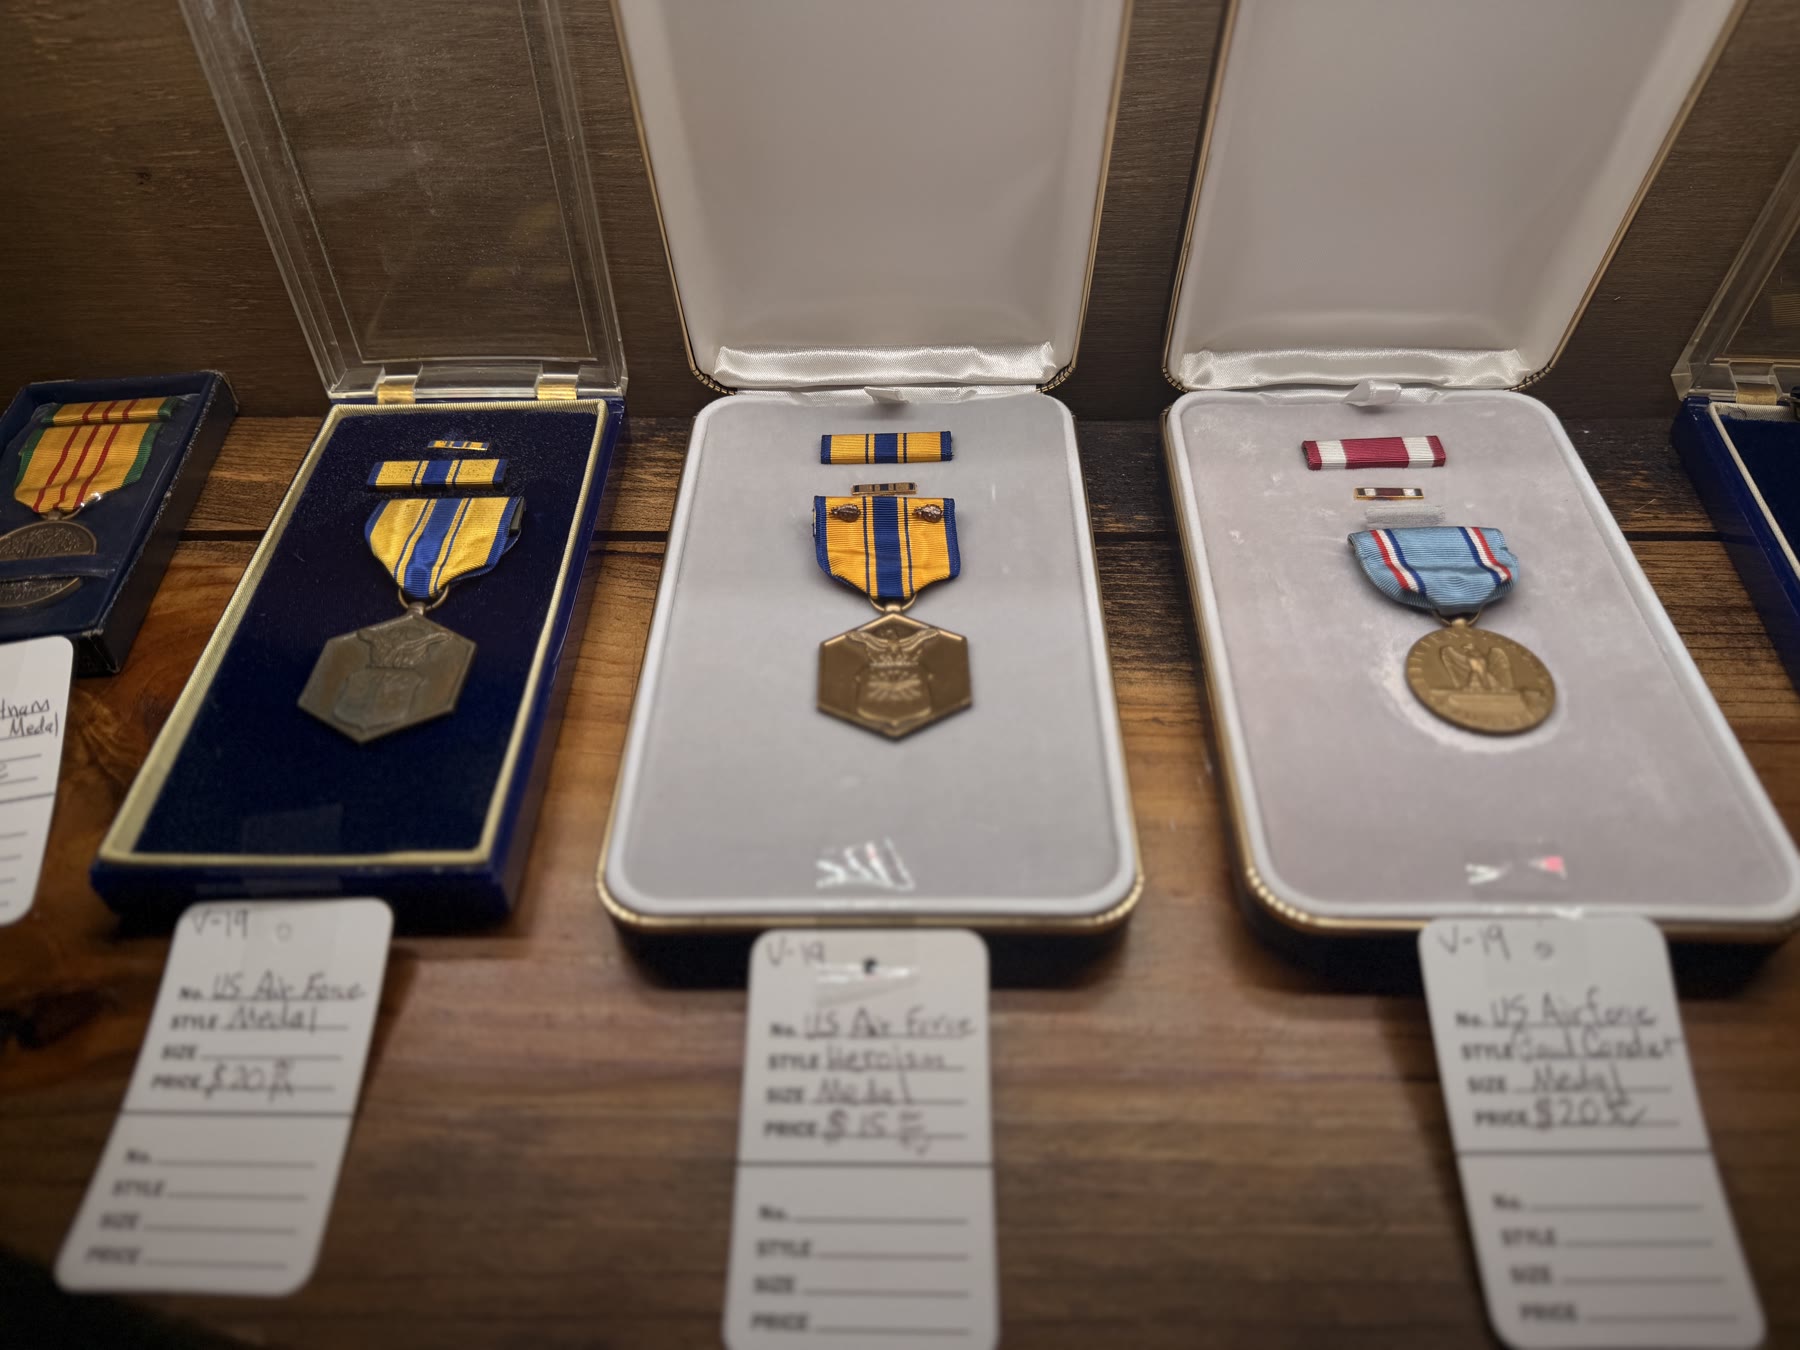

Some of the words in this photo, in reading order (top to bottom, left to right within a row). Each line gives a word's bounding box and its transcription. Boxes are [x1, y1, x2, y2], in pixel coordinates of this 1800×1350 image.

[10, 712, 59, 737] Medal
[1438, 925, 1511, 960] V-19
[211, 970, 244, 1000] US
[252, 969, 294, 1001] Air
[170, 1015, 219, 1030] STYLE
[228, 1002, 317, 1034] Medal
[1490, 994, 1529, 1028] US
[803, 1009, 840, 1039] US
[849, 1007, 891, 1038] Air
[161, 1044, 199, 1060] SIZE
[1462, 1043, 1514, 1060] STYLE
[768, 1054, 819, 1071] STYLE
[151, 1074, 202, 1089] PRICE
[1467, 1076, 1507, 1093] SIZE
[766, 1086, 805, 1103] SIZE
[1475, 1108, 1527, 1125] PRICE
[764, 1120, 818, 1137] PRICE
[111, 1180, 166, 1198] STYLE
[1501, 1228, 1557, 1247] STYLE
[756, 1239, 813, 1259] STYLE
